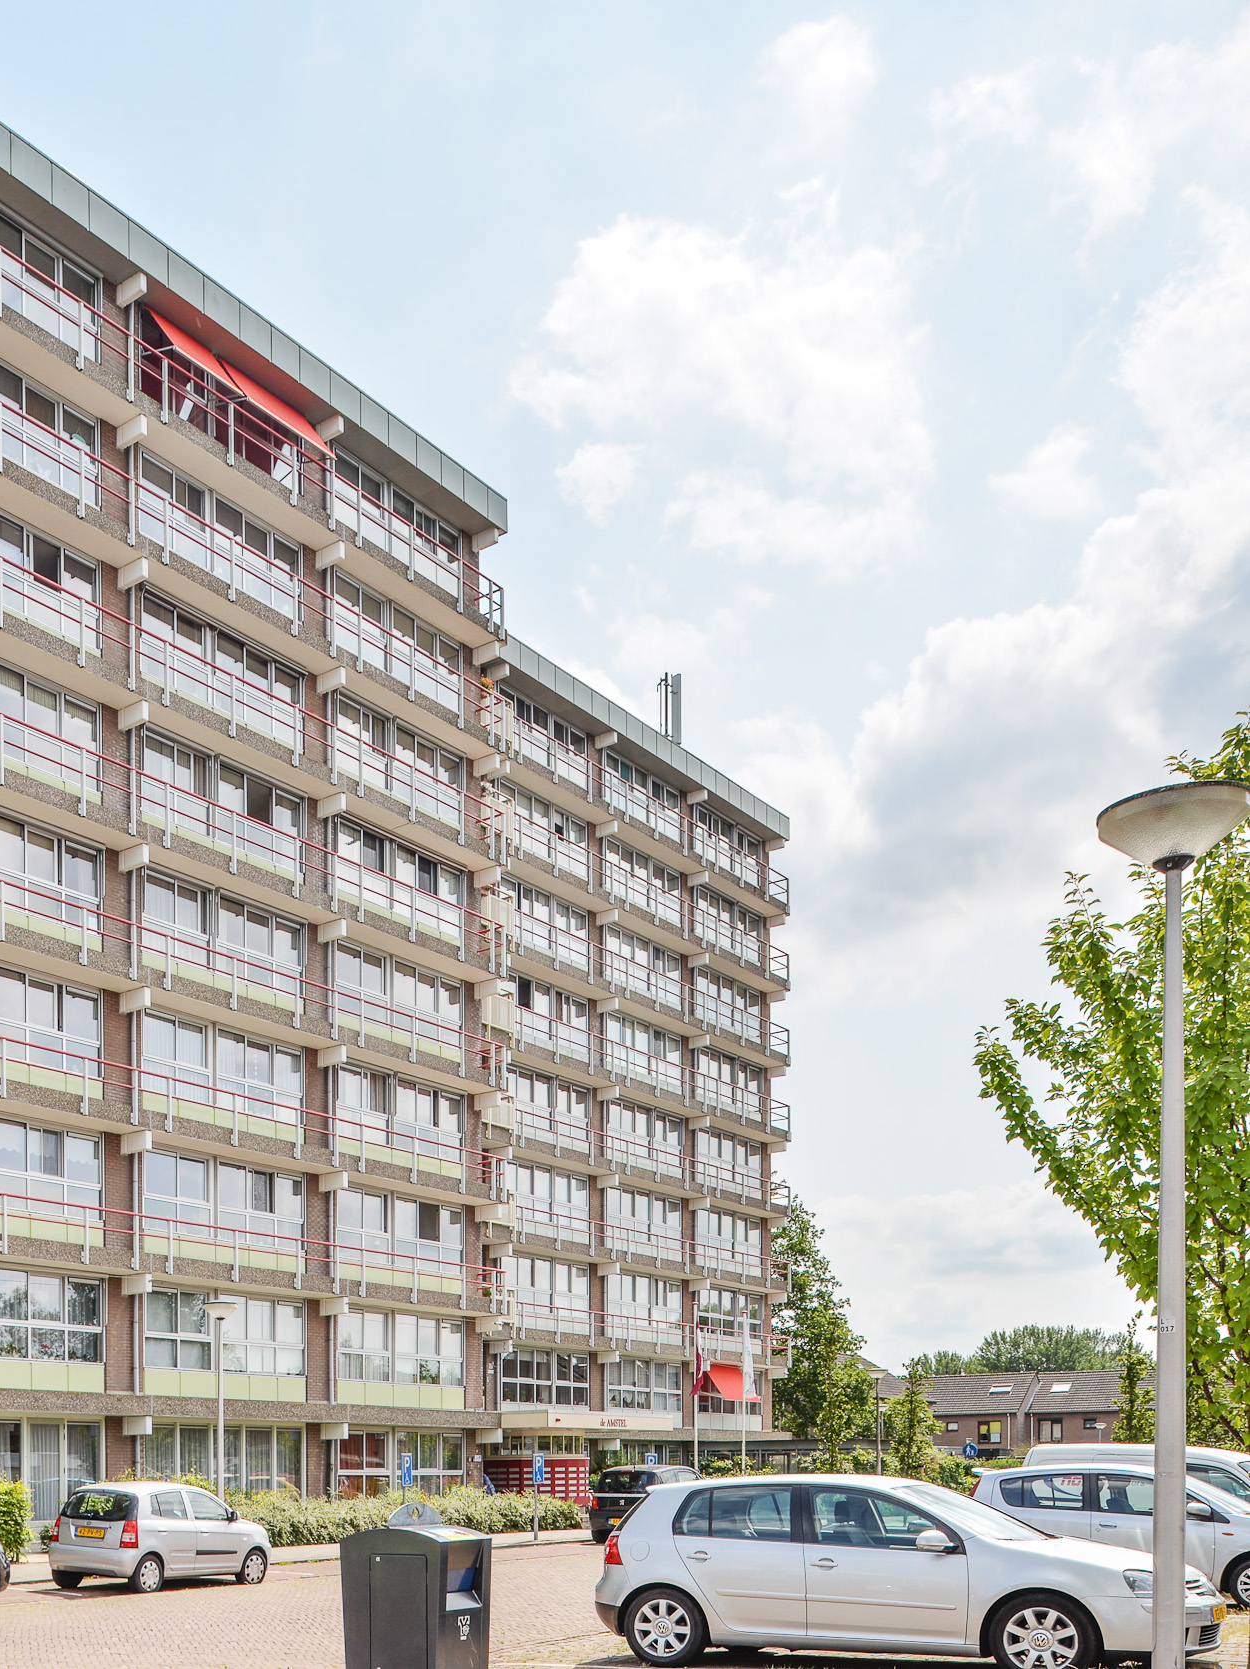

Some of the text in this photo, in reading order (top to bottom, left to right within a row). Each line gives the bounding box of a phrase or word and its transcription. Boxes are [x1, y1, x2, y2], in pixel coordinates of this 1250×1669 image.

[1160, 1325, 1175, 1333] 017
[600, 1418, 627, 1428] de AMSTEL
[404, 1456, 411, 1474] P
[535, 1456, 543, 1472] P
[647, 1456, 655, 1465] P
